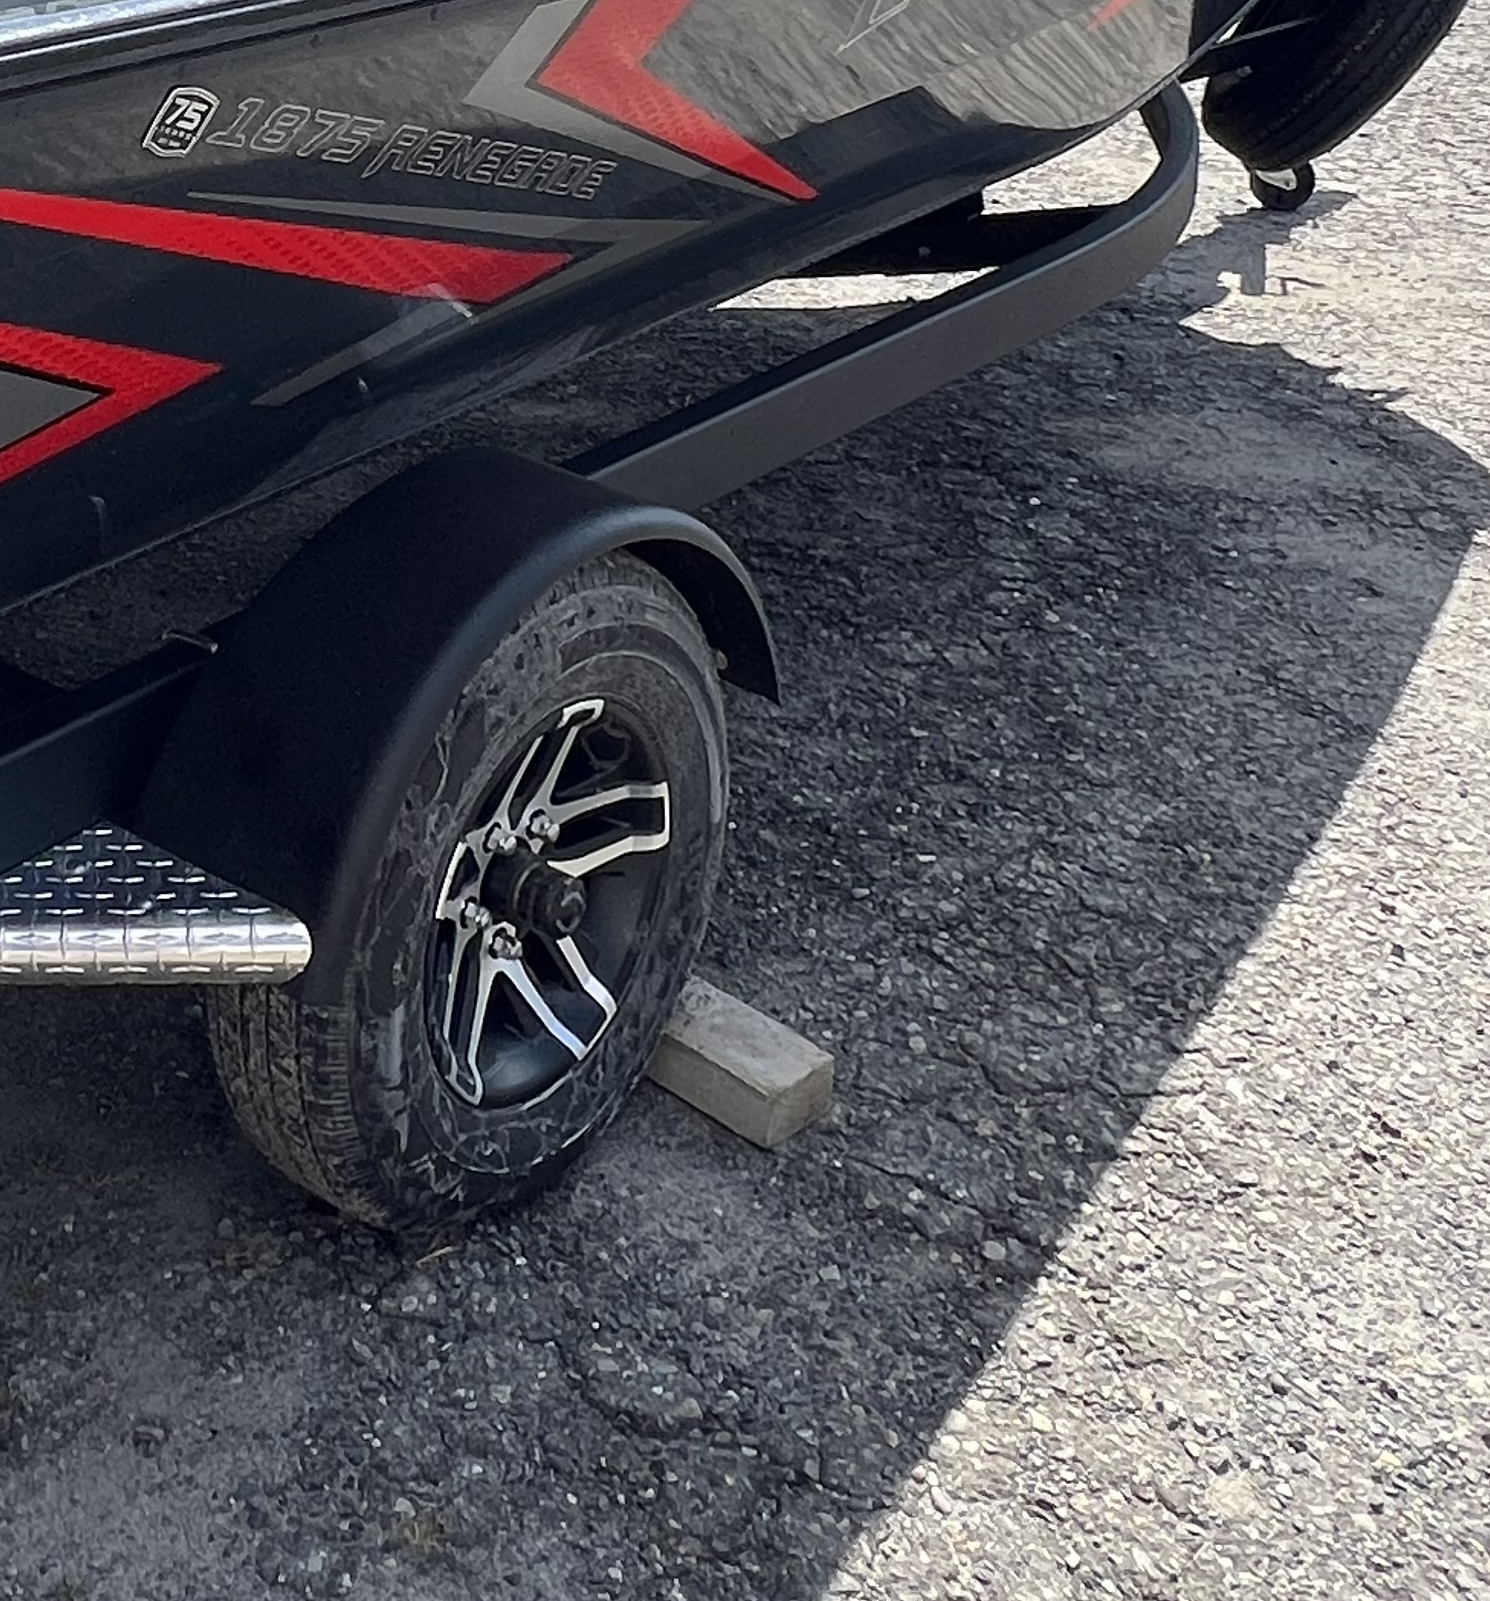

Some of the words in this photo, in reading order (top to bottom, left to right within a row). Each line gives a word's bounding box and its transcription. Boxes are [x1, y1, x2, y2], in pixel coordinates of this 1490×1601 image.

[164, 97, 209, 131] 75
[205, 97, 385, 163] 1875
[360, 123, 618, 200] RENEGADE
